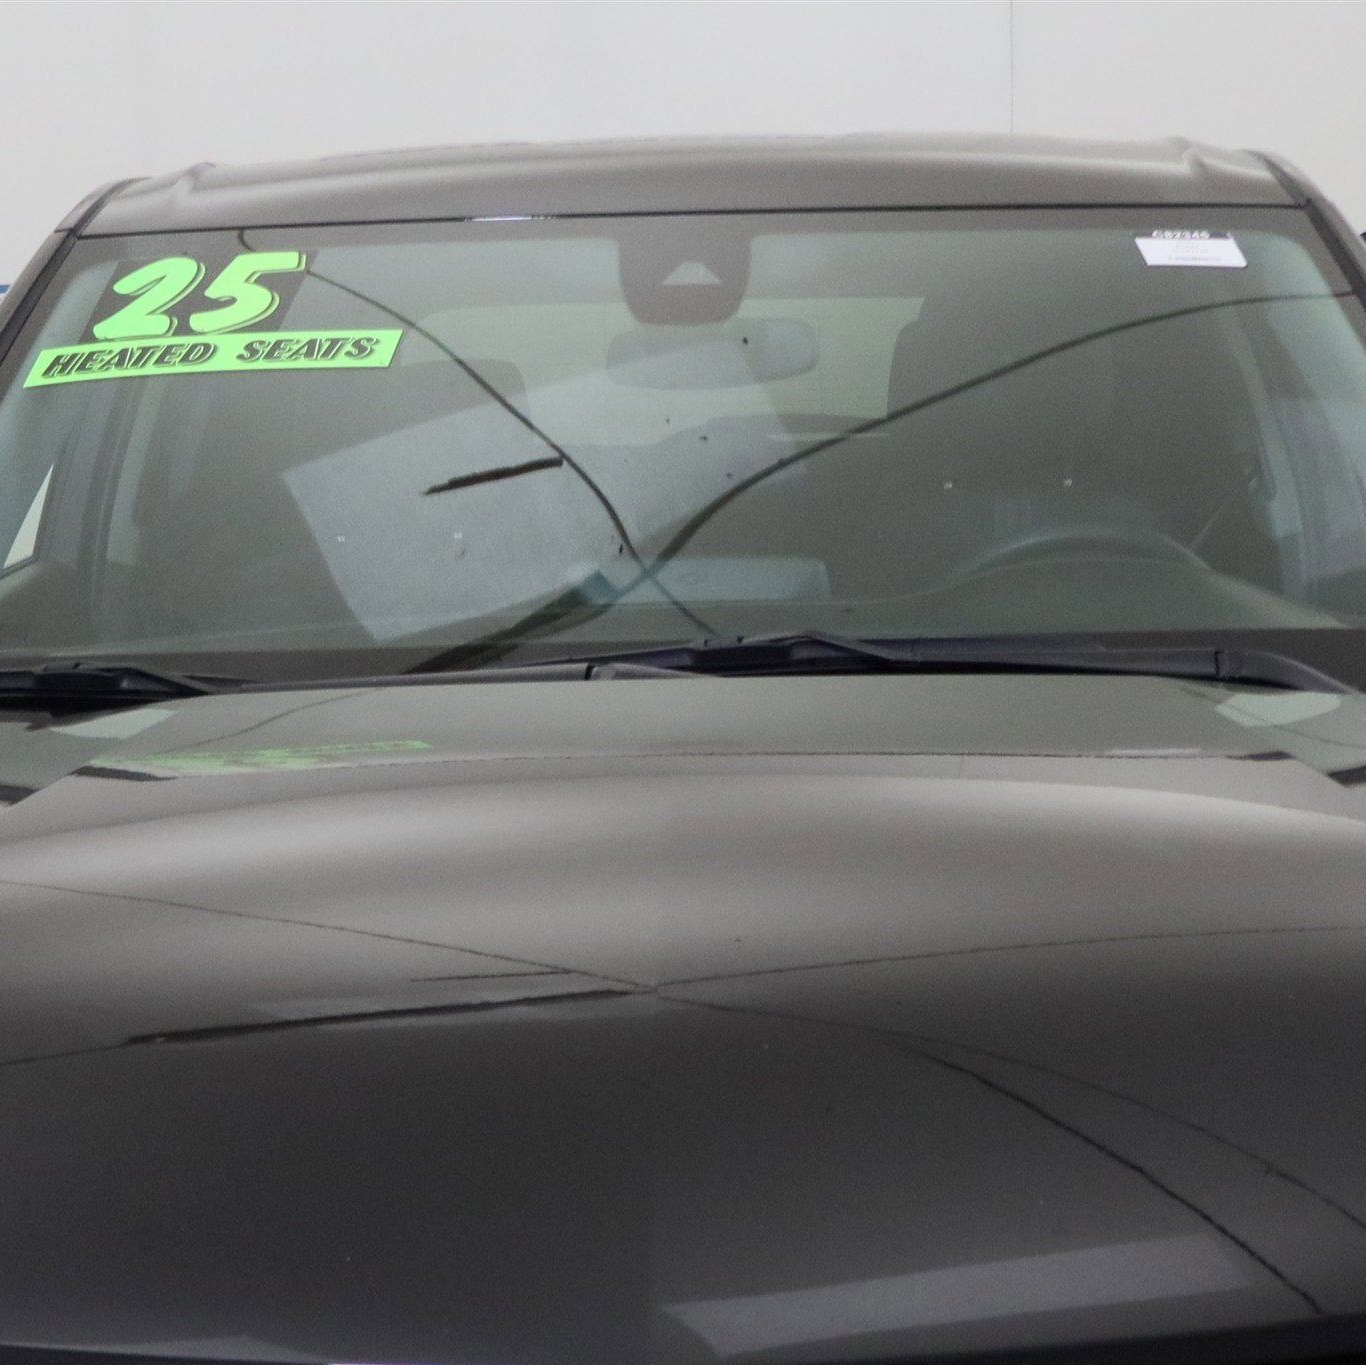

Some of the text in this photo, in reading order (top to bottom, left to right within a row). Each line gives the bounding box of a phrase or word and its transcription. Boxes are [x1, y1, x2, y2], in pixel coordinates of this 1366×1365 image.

[92, 250, 307, 341] 25
[41, 335, 380, 379] HEATED SEATS
